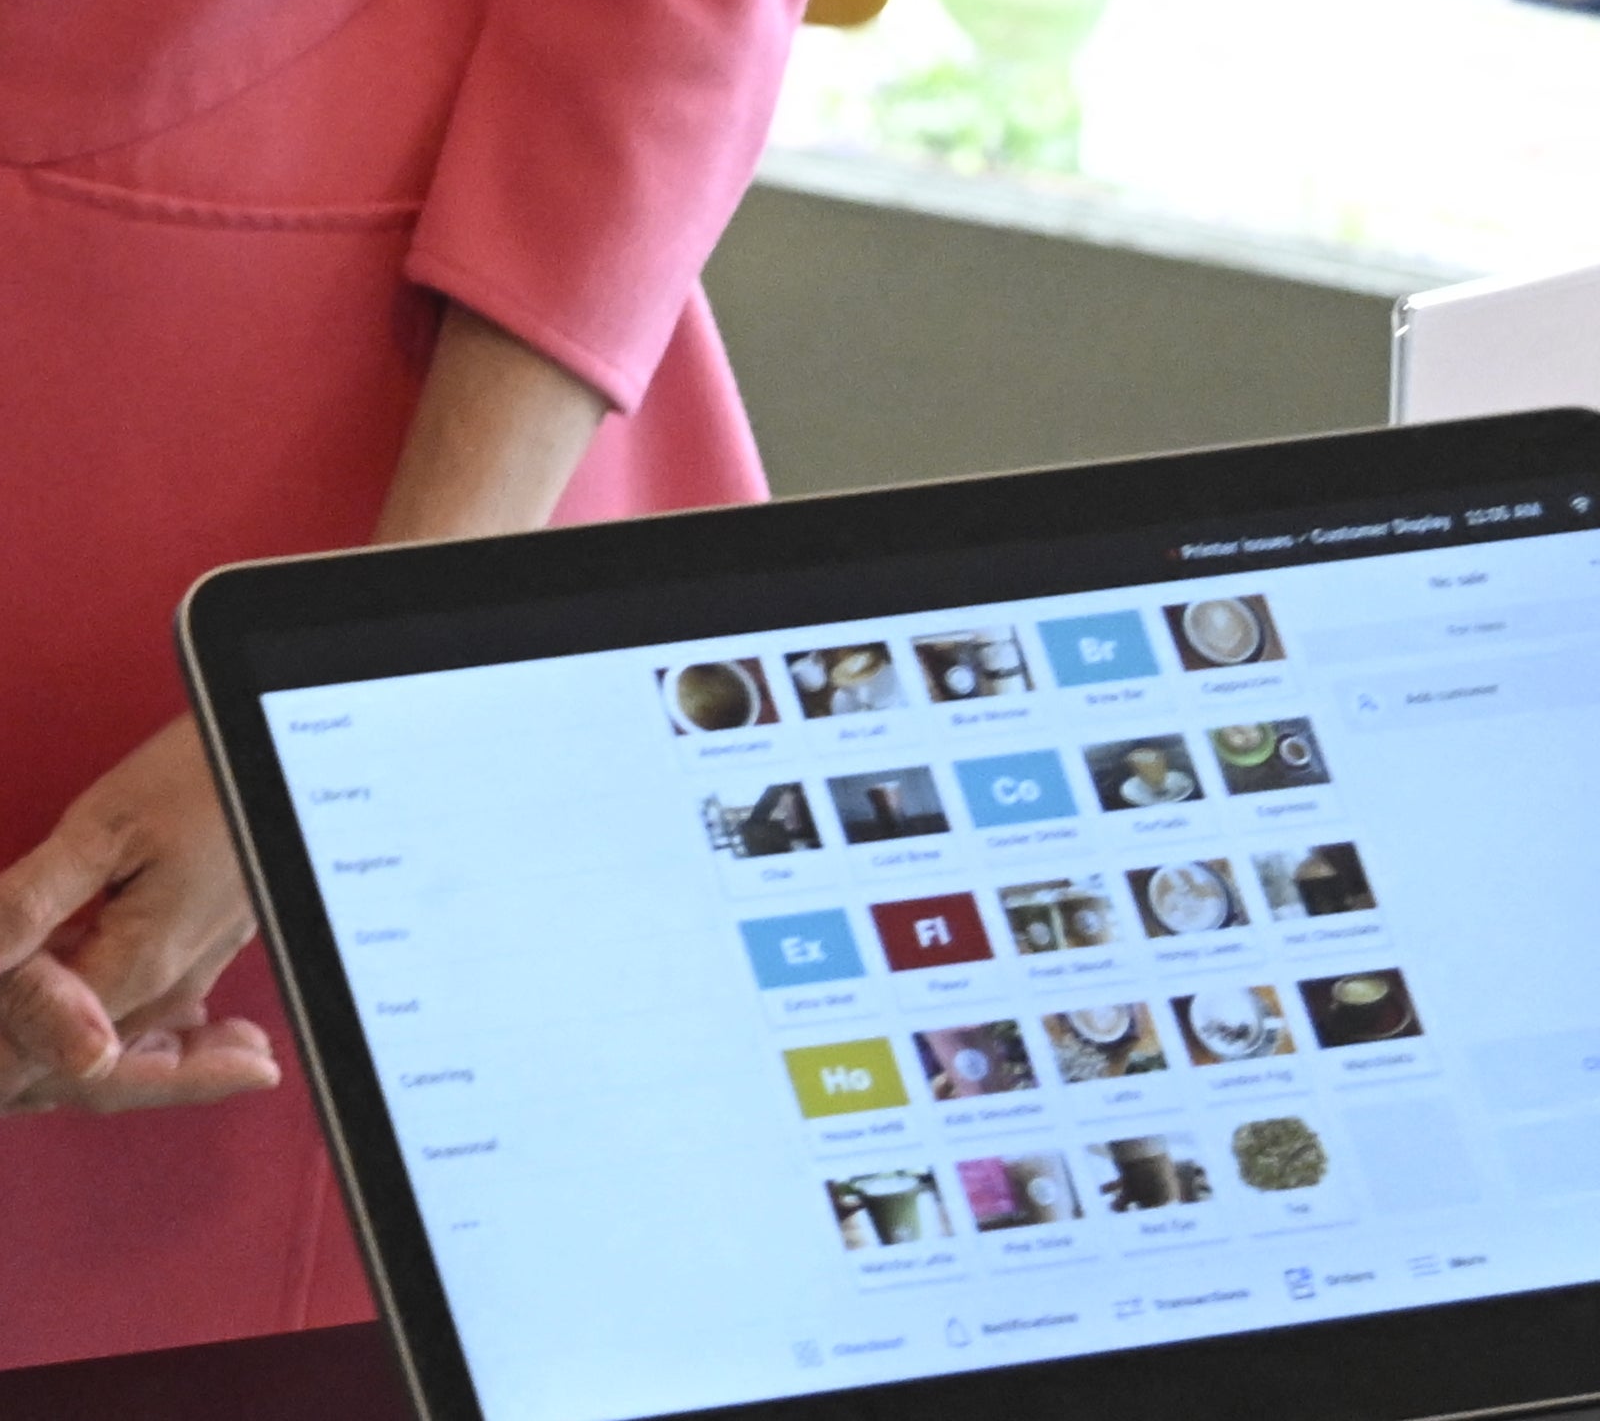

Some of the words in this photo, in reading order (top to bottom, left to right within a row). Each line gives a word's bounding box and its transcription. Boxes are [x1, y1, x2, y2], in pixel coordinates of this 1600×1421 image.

[1078, 636, 1119, 663] Br
[991, 775, 1042, 806] Co
[779, 935, 829, 965] Ex
[819, 1066, 874, 1097] Ho
